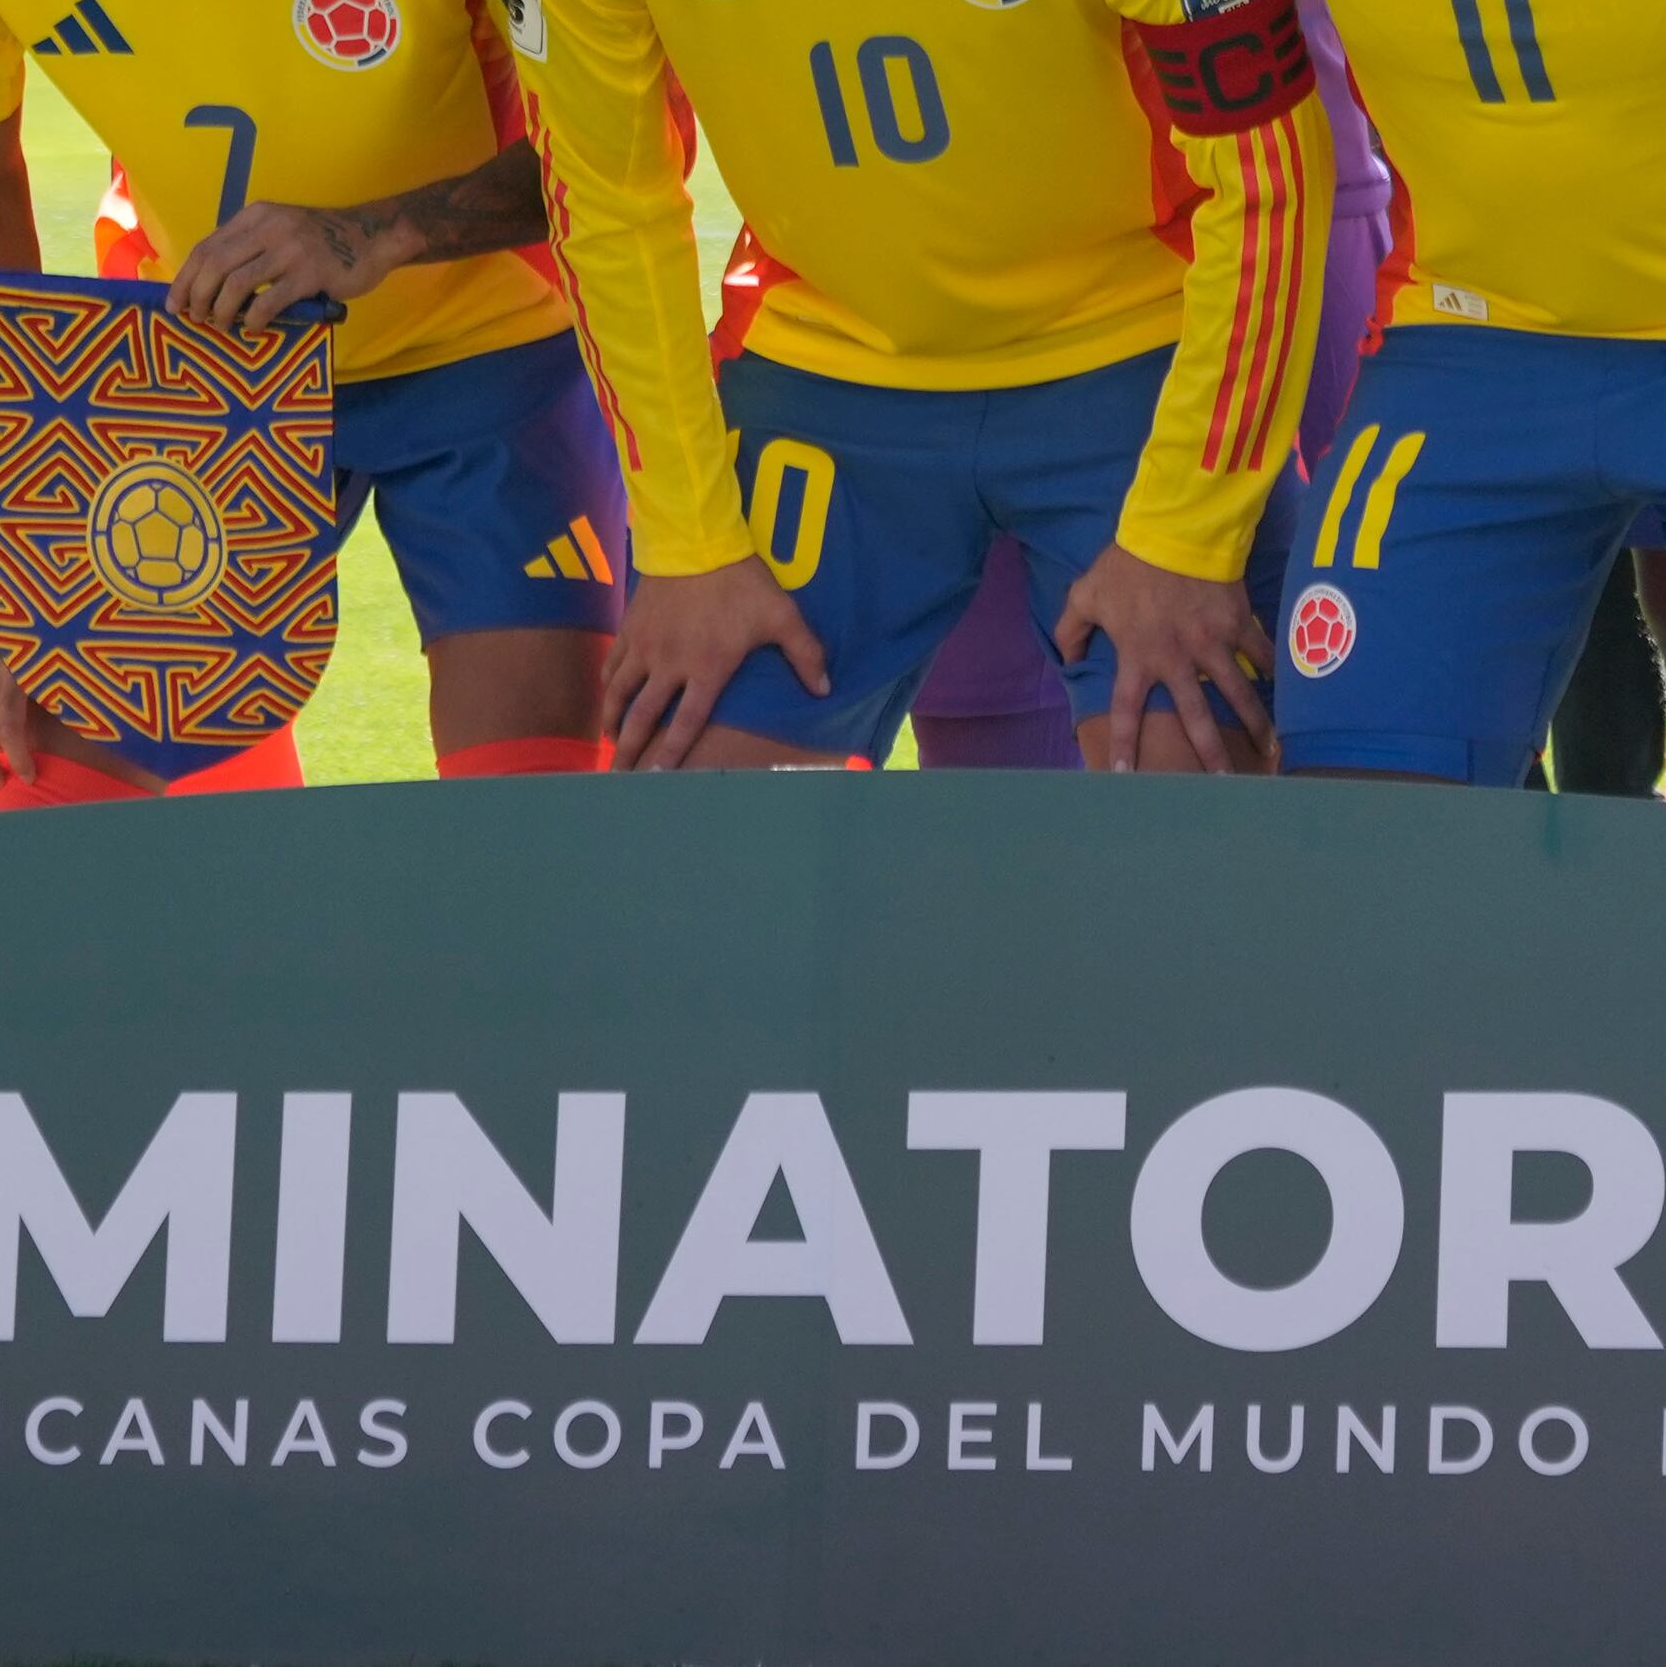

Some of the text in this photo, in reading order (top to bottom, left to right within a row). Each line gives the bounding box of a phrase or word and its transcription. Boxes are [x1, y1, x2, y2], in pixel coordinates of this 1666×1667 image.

[809, 34, 951, 168] 10
[1199, 31, 1273, 112] C
[184, 103, 257, 226] 7
[1313, 424, 1426, 570] 11
[472, 1399, 787, 1470] COPA
[855, 1401, 1073, 1472] DEL
[1140, 1402, 1590, 1477] MUNDO
